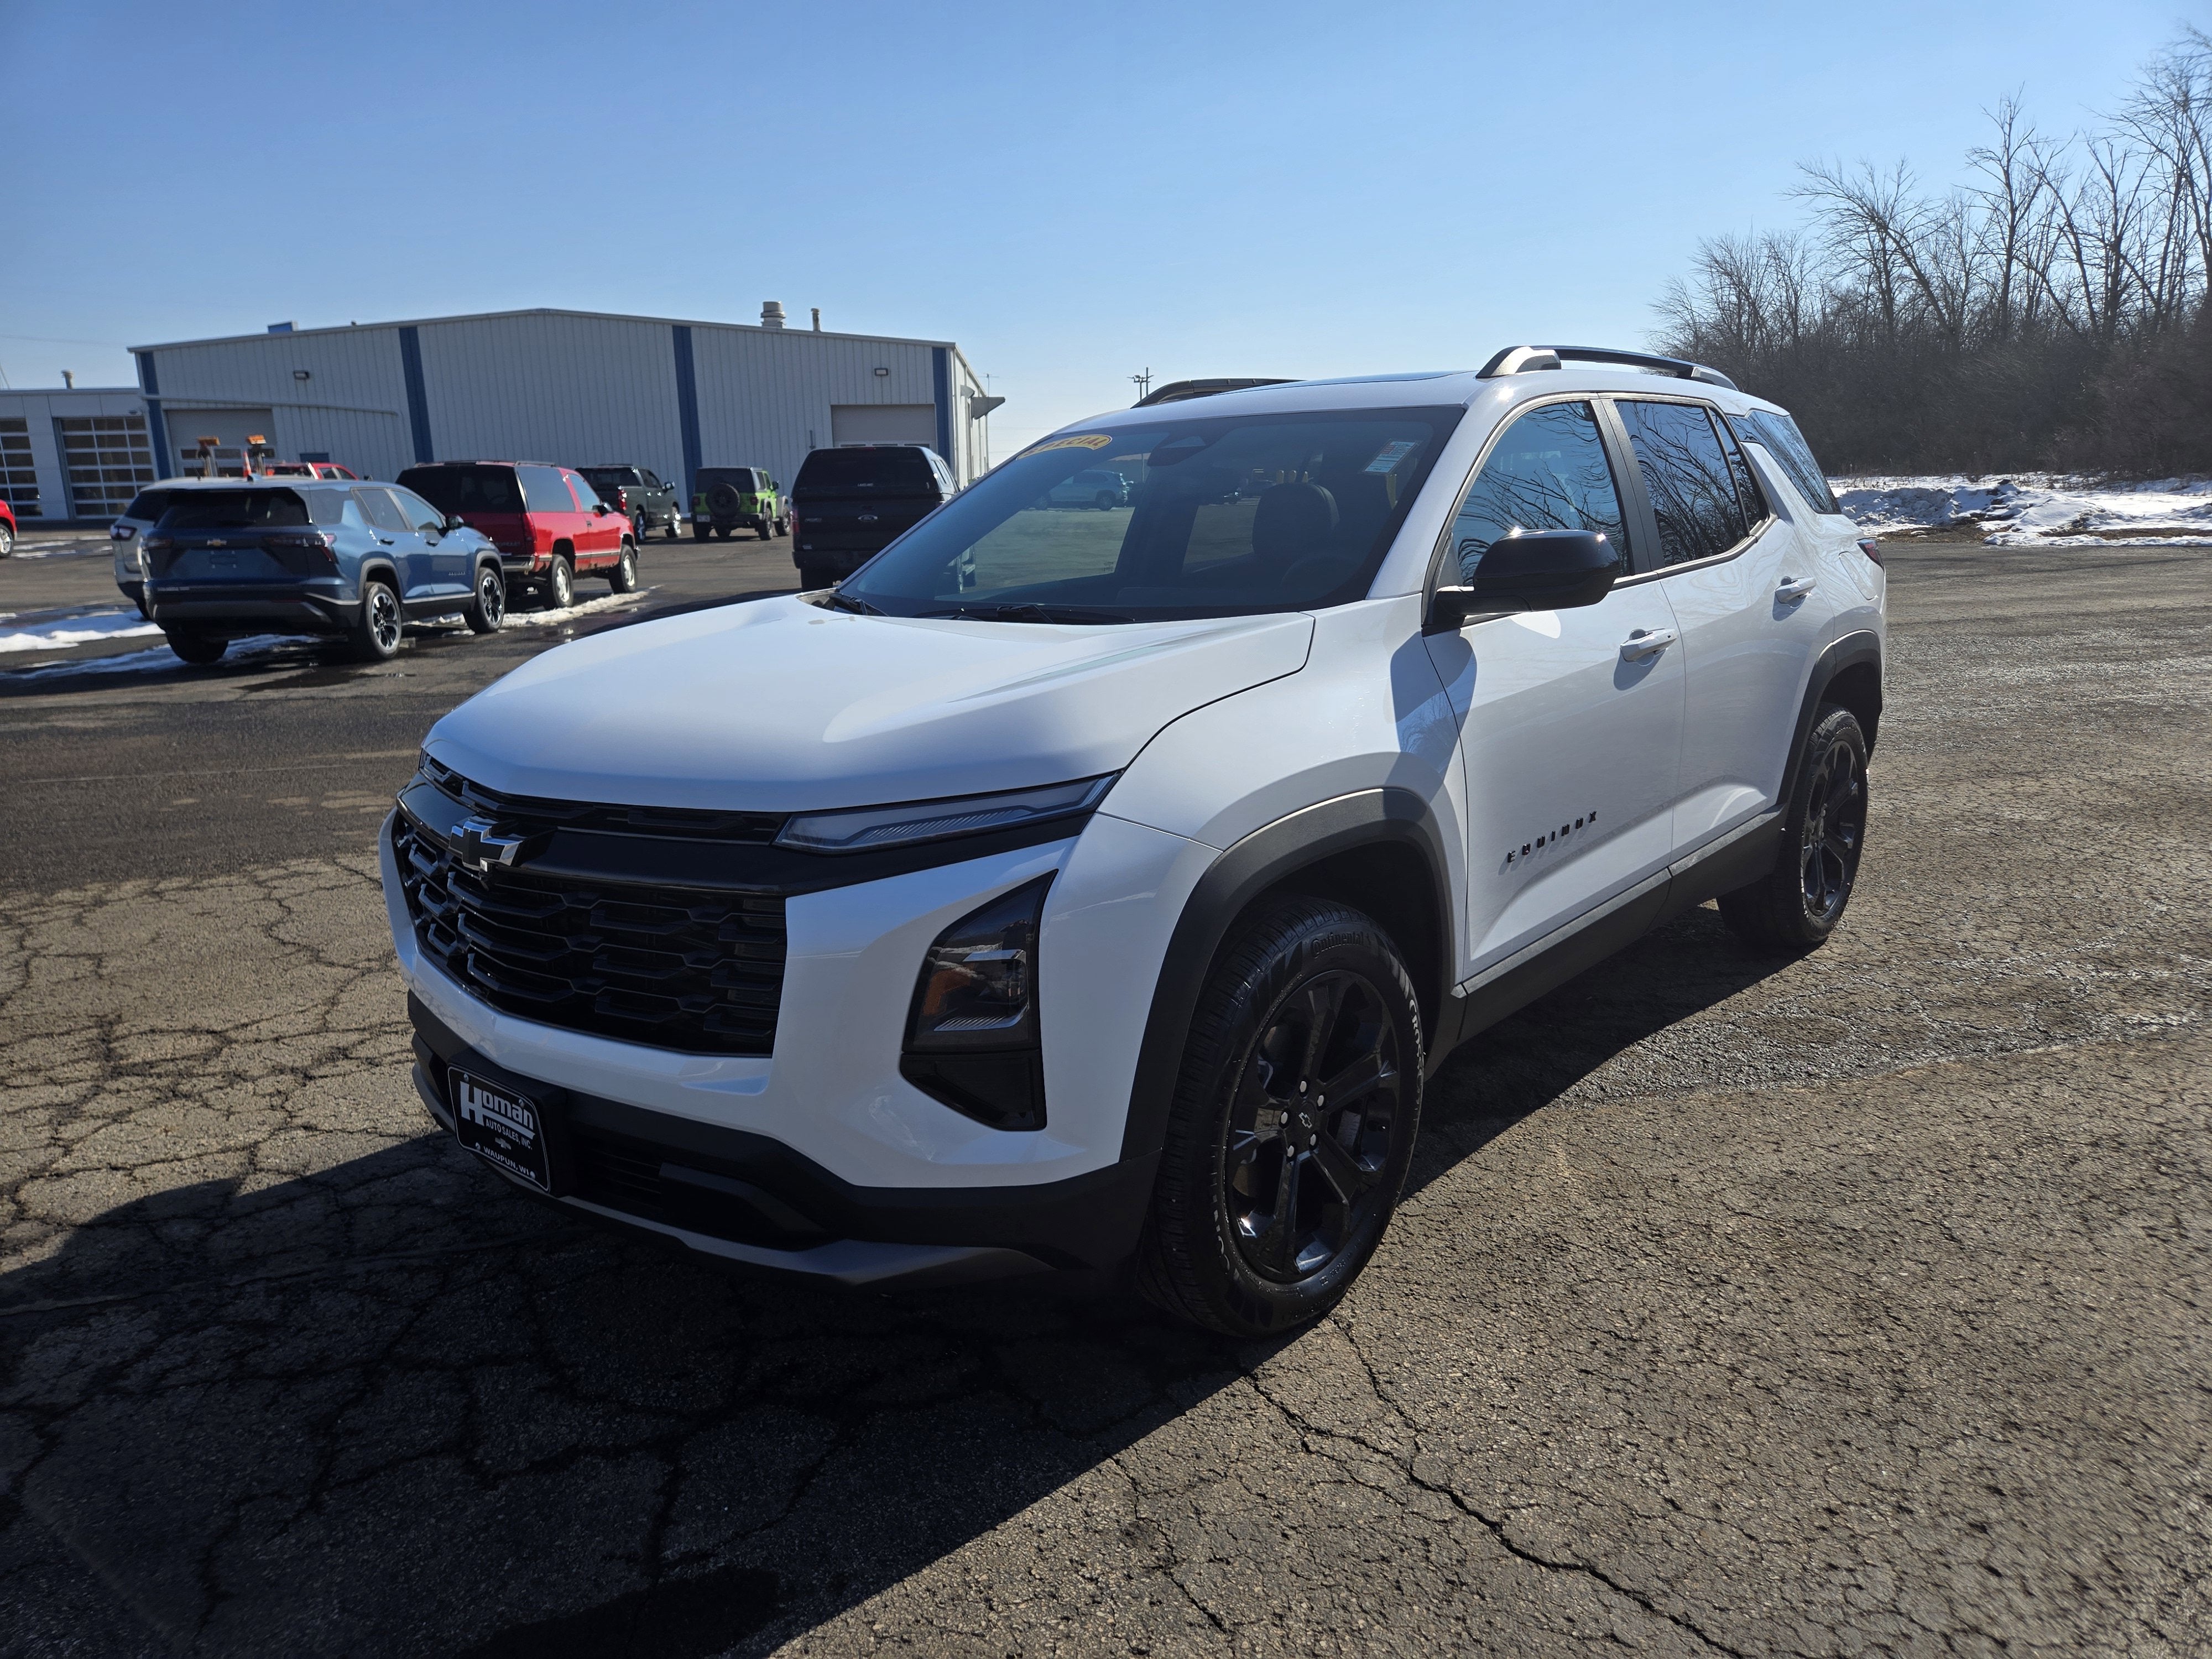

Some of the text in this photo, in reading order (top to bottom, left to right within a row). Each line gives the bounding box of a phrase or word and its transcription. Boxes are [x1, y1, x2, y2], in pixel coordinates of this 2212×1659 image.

[1024, 437, 1107, 456] SPECIAL
[1507, 810, 1597, 863] EQUINOX
[1310, 931, 1364, 959] Continental
[460, 1081, 534, 1130] Homan
[486, 1118, 533, 1150] AUTO SALES, INC.
[483, 1145, 529, 1176] WAUPUN, WI
